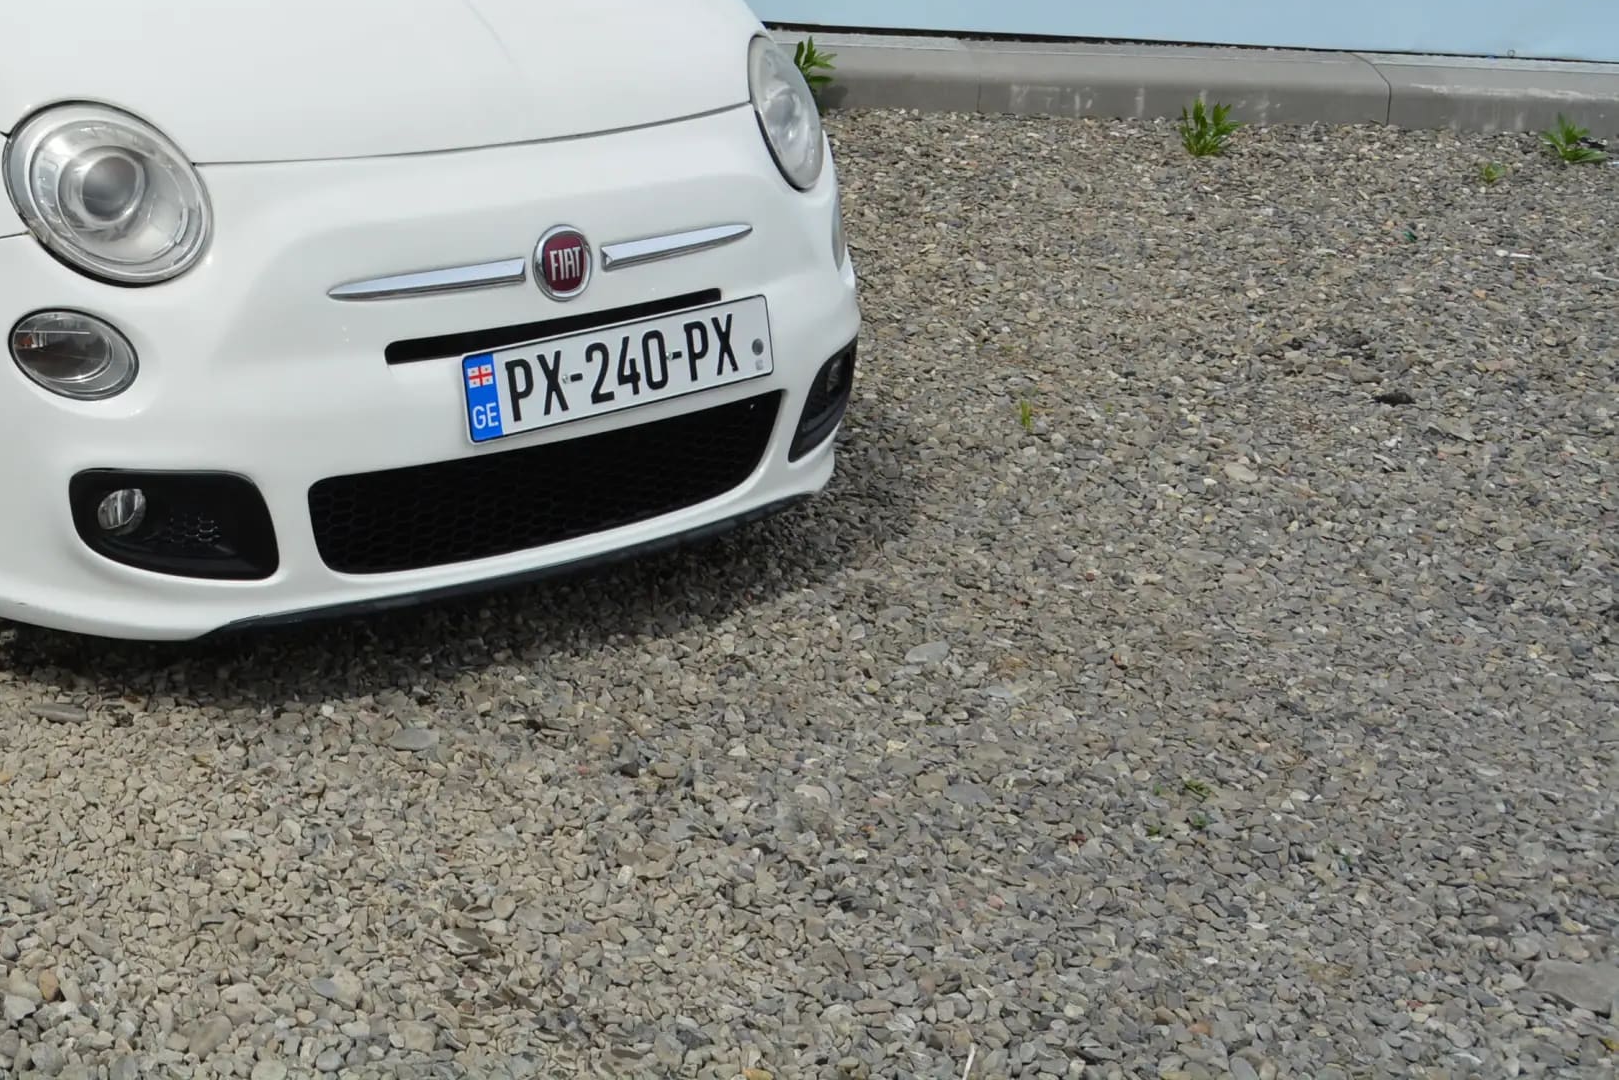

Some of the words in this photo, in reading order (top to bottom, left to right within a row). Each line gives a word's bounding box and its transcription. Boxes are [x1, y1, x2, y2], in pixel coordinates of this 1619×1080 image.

[549, 246, 582, 282] FIAT
[504, 313, 739, 422] PX-240-PX
[472, 402, 499, 429] GE
